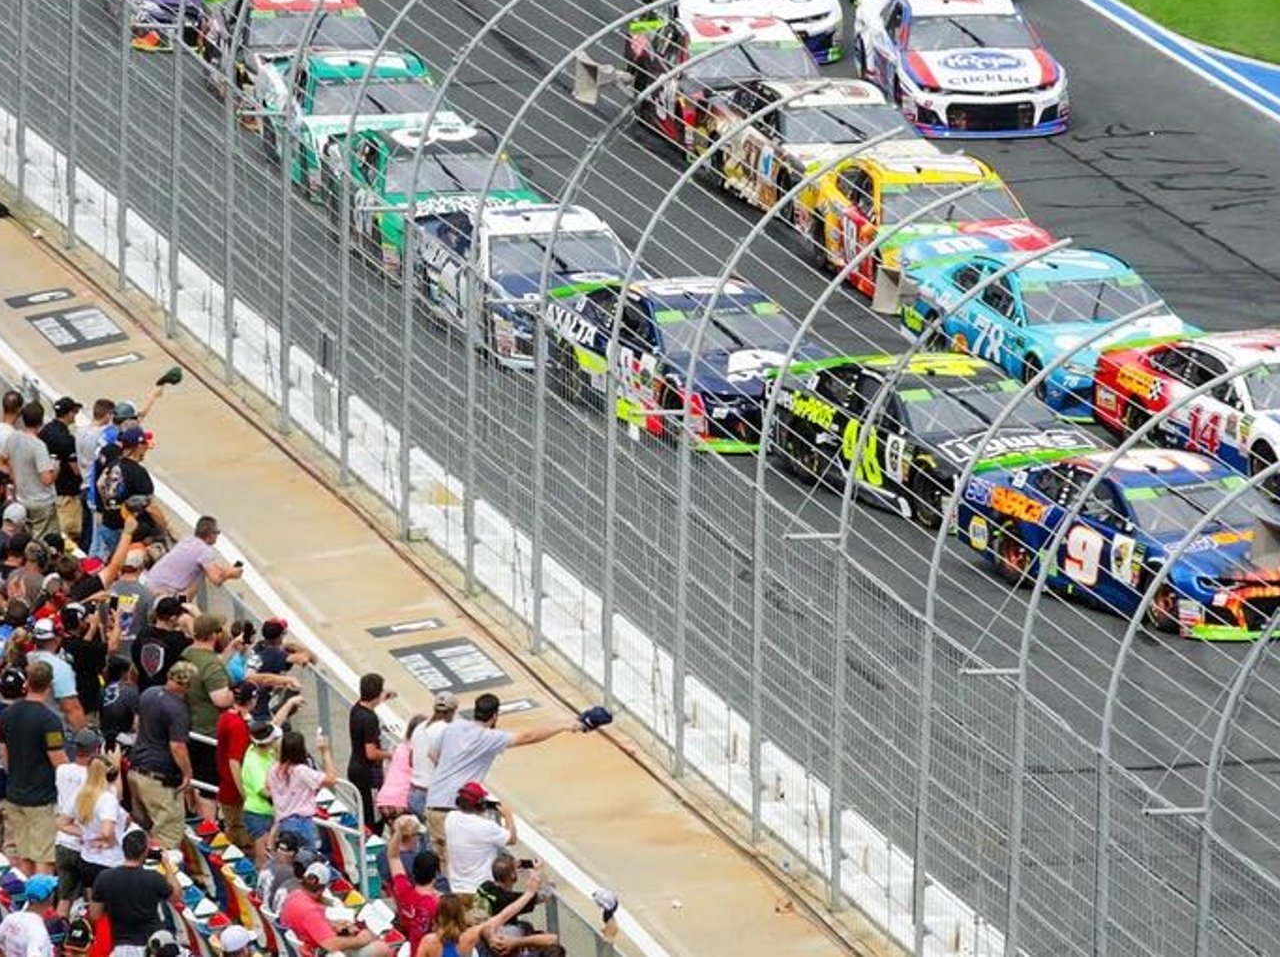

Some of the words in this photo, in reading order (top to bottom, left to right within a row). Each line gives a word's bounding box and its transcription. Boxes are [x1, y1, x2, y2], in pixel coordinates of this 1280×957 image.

[944, 52, 1023, 70] Kroger
[947, 72, 1032, 87] ClickList
[972, 313, 1005, 363] 78
[1185, 404, 1222, 455] 14
[1064, 524, 1104, 587] 9
